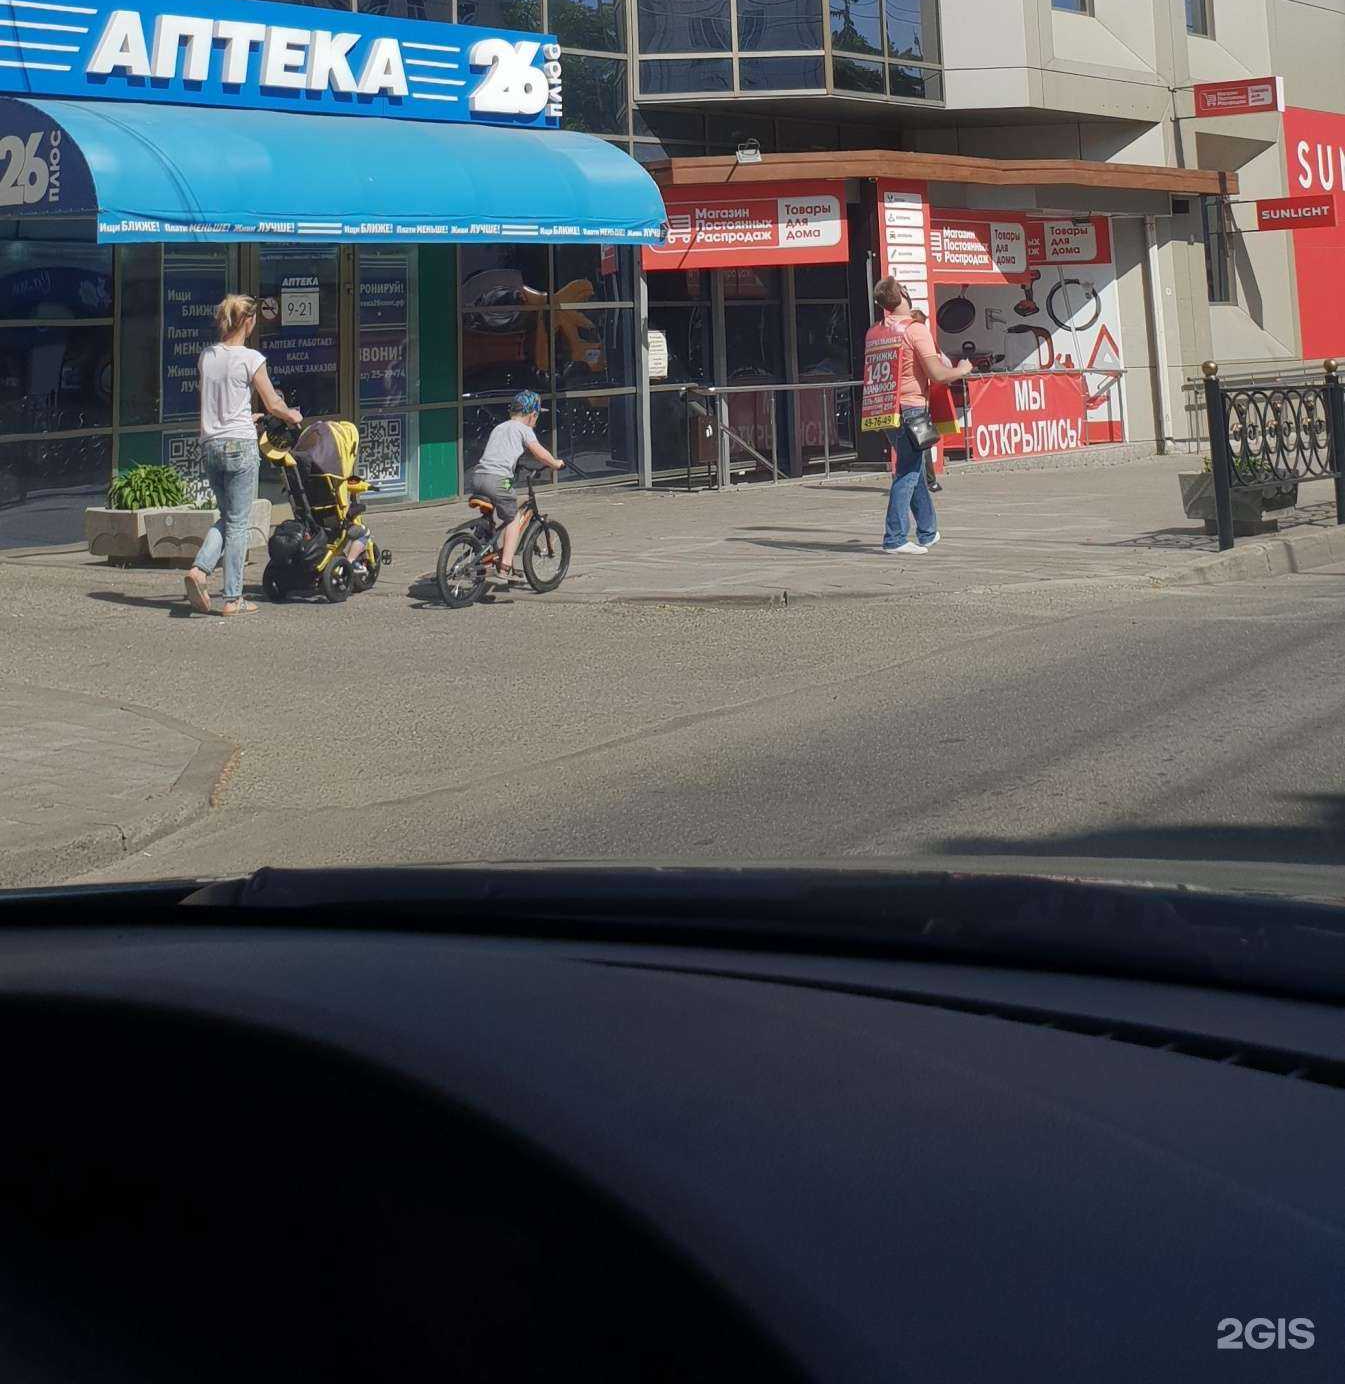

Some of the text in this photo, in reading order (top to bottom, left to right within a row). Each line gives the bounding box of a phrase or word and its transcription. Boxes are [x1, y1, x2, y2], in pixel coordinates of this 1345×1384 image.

[86, 10, 409, 96] АПТЕКА
[469, 38, 549, 115] 26
[0, 130, 61, 206] 26 ПЛЮС
[695, 208, 750, 220] Магазин
[785, 204, 831, 216] Товары
[1262, 205, 1330, 220] SUNLIGHT
[100, 222, 121, 234] Ищи
[121, 220, 160, 232] БЛИЖЕ!
[257, 222, 295, 233] ЛУЧШЕ!
[360, 223, 393, 234] БЛИЖЕ!
[469, 223, 500, 234] ЛУЧШЕ!
[696, 218, 772, 231] Постоянных
[786, 218, 809, 229] для
[553, 226, 581, 235] БЛИЖЕ!
[696, 230, 772, 243] Распродаж
[786, 228, 821, 240] дома
[943, 227, 976, 240] Магазин
[995, 229, 1021, 242] Товары
[1049, 226, 1088, 236] Товары
[995, 243, 1009, 253] для
[1051, 237, 1070, 247] для
[1051, 247, 1080, 256] дома
[944, 252, 990, 265] Распродаж
[996, 254, 1017, 266] дома
[282, 277, 319, 287] АПТЕКА
[360, 281, 404, 294] РОНИРУЙ!
[167, 289, 192, 302] Ищи
[287, 302, 312, 316] 9-21
[167, 326, 199, 339] Плати
[286, 352, 309, 361] КАССА
[360, 346, 402, 362] ВОНИ!
[865, 351, 897, 364] СТРИЖКА
[1014, 379, 1046, 411] МЫ
[976, 417, 1082, 457] ОТКРЫЛИСЬ!
